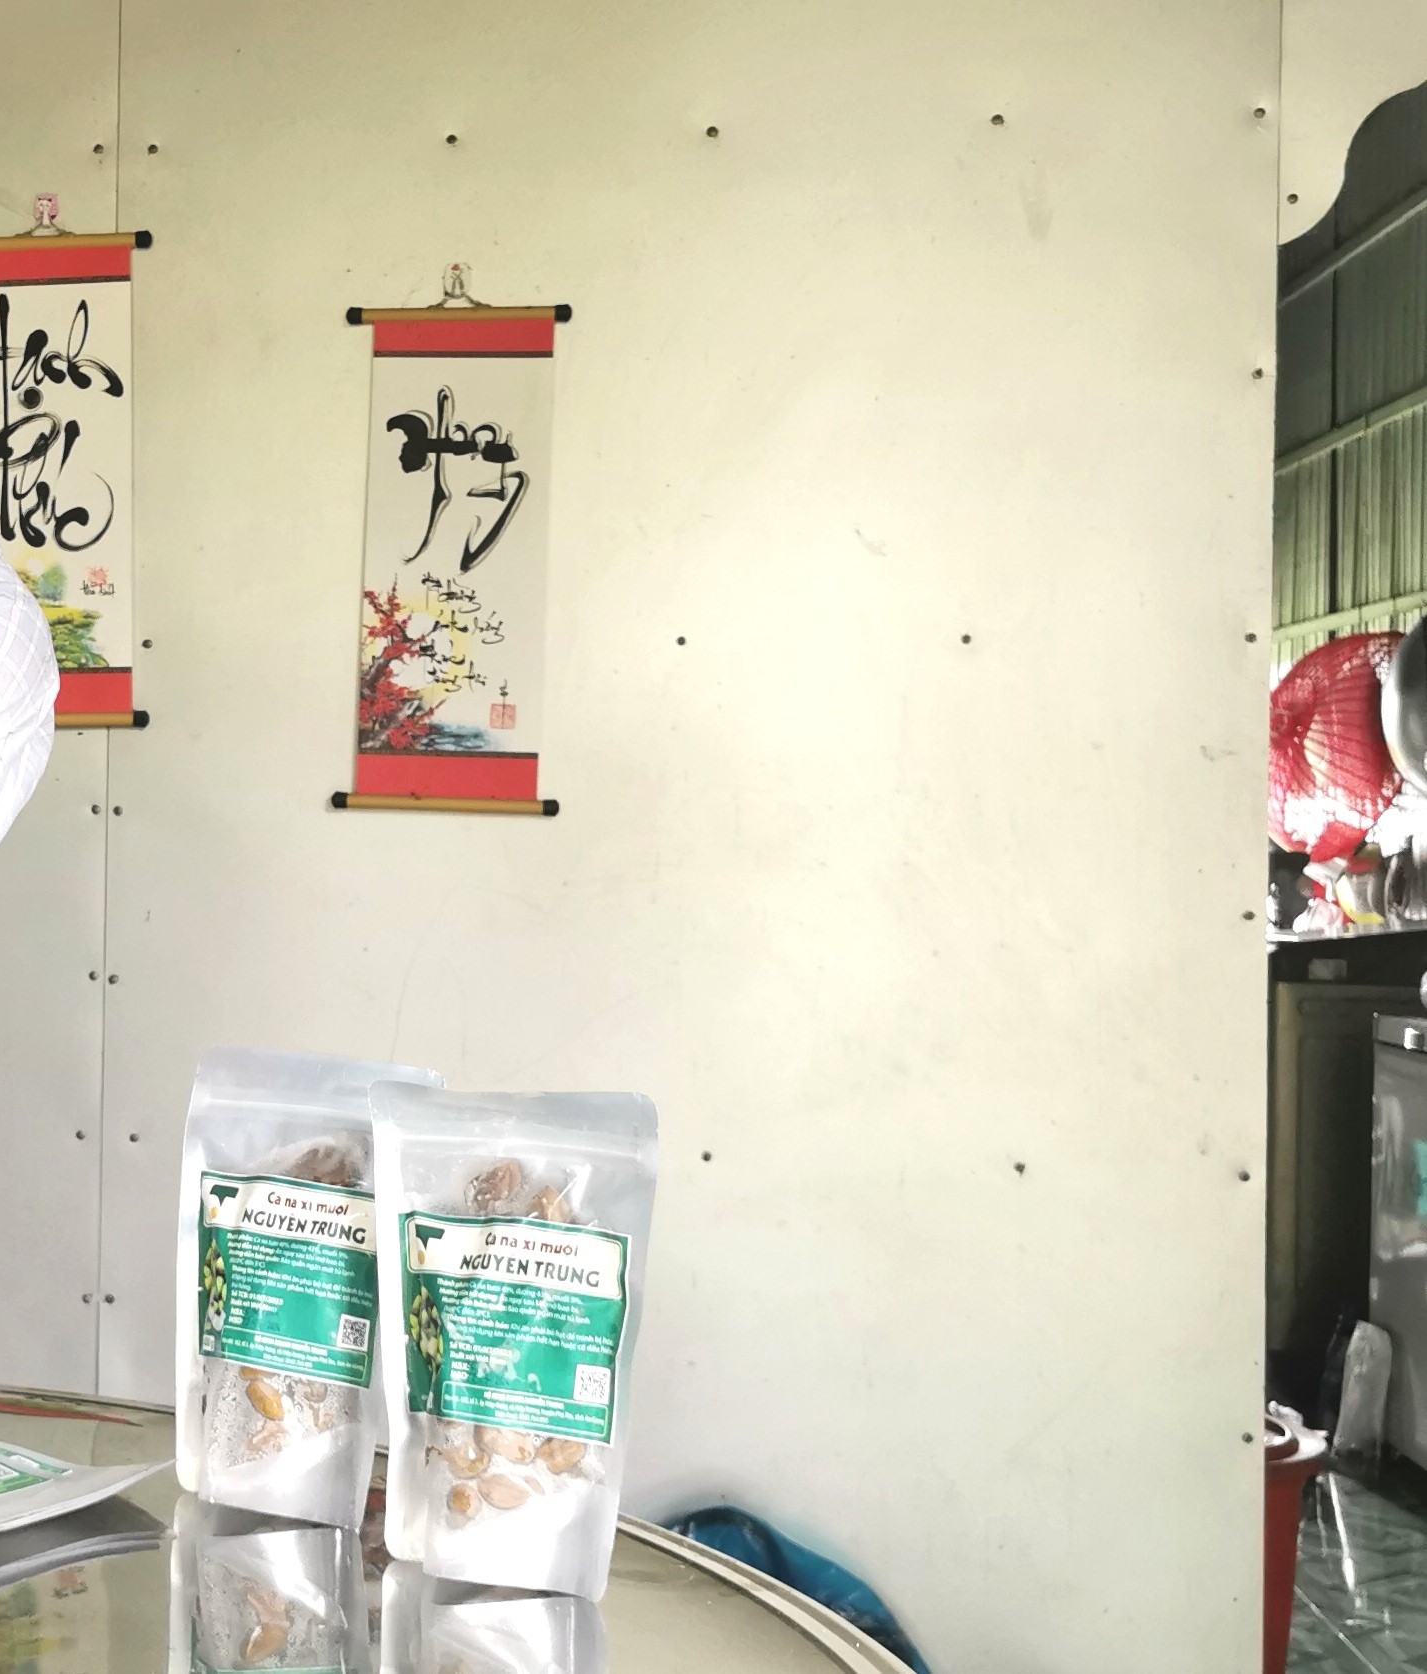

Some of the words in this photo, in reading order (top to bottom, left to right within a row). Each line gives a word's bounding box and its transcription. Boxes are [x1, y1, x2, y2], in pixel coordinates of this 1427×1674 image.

[284, 1198, 297, 1208] na
[310, 1220, 367, 1244] TRUNG
[500, 1236, 517, 1248] na
[534, 1260, 600, 1287] TRUNG
